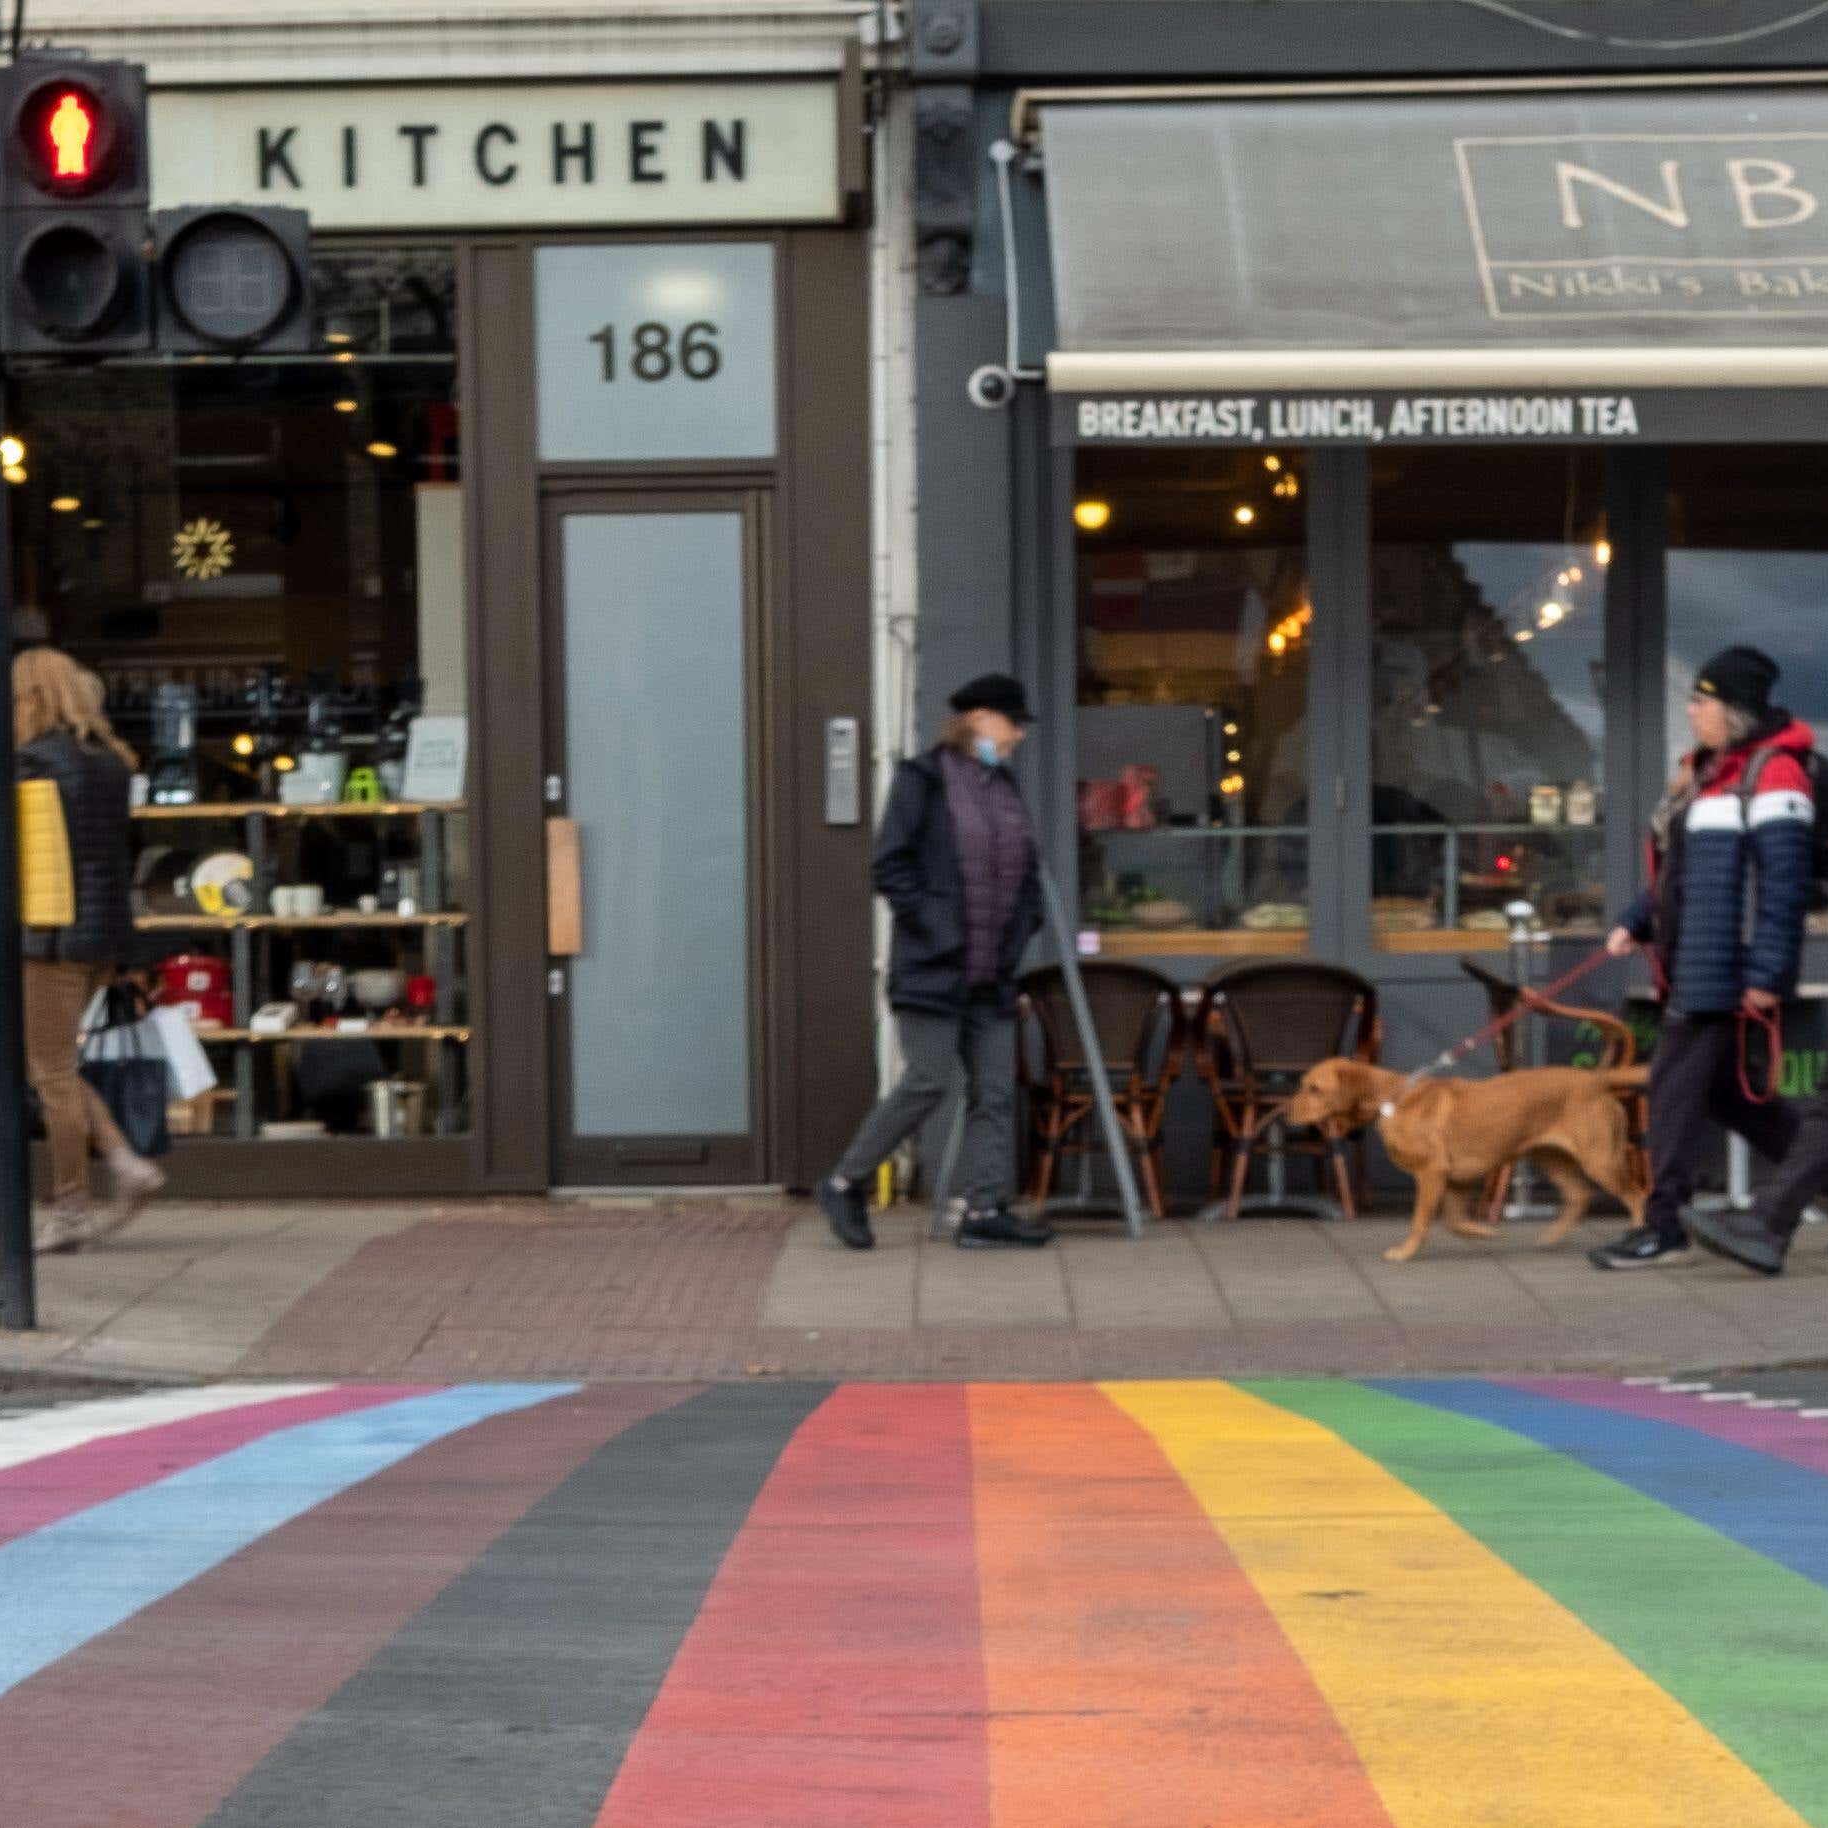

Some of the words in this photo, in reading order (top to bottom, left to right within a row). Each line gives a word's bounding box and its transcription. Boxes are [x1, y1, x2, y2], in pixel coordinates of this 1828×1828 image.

[256, 118, 746, 190] KITCHEN
[1507, 265, 1705, 299] Nikki's
[587, 320, 722, 383] 186
[1077, 400, 1264, 441] BREAKFAST,
[1271, 399, 1384, 442] LUNCH,
[1388, 398, 1573, 438] AFTERNOON
[1579, 396, 1640, 435] TEA
